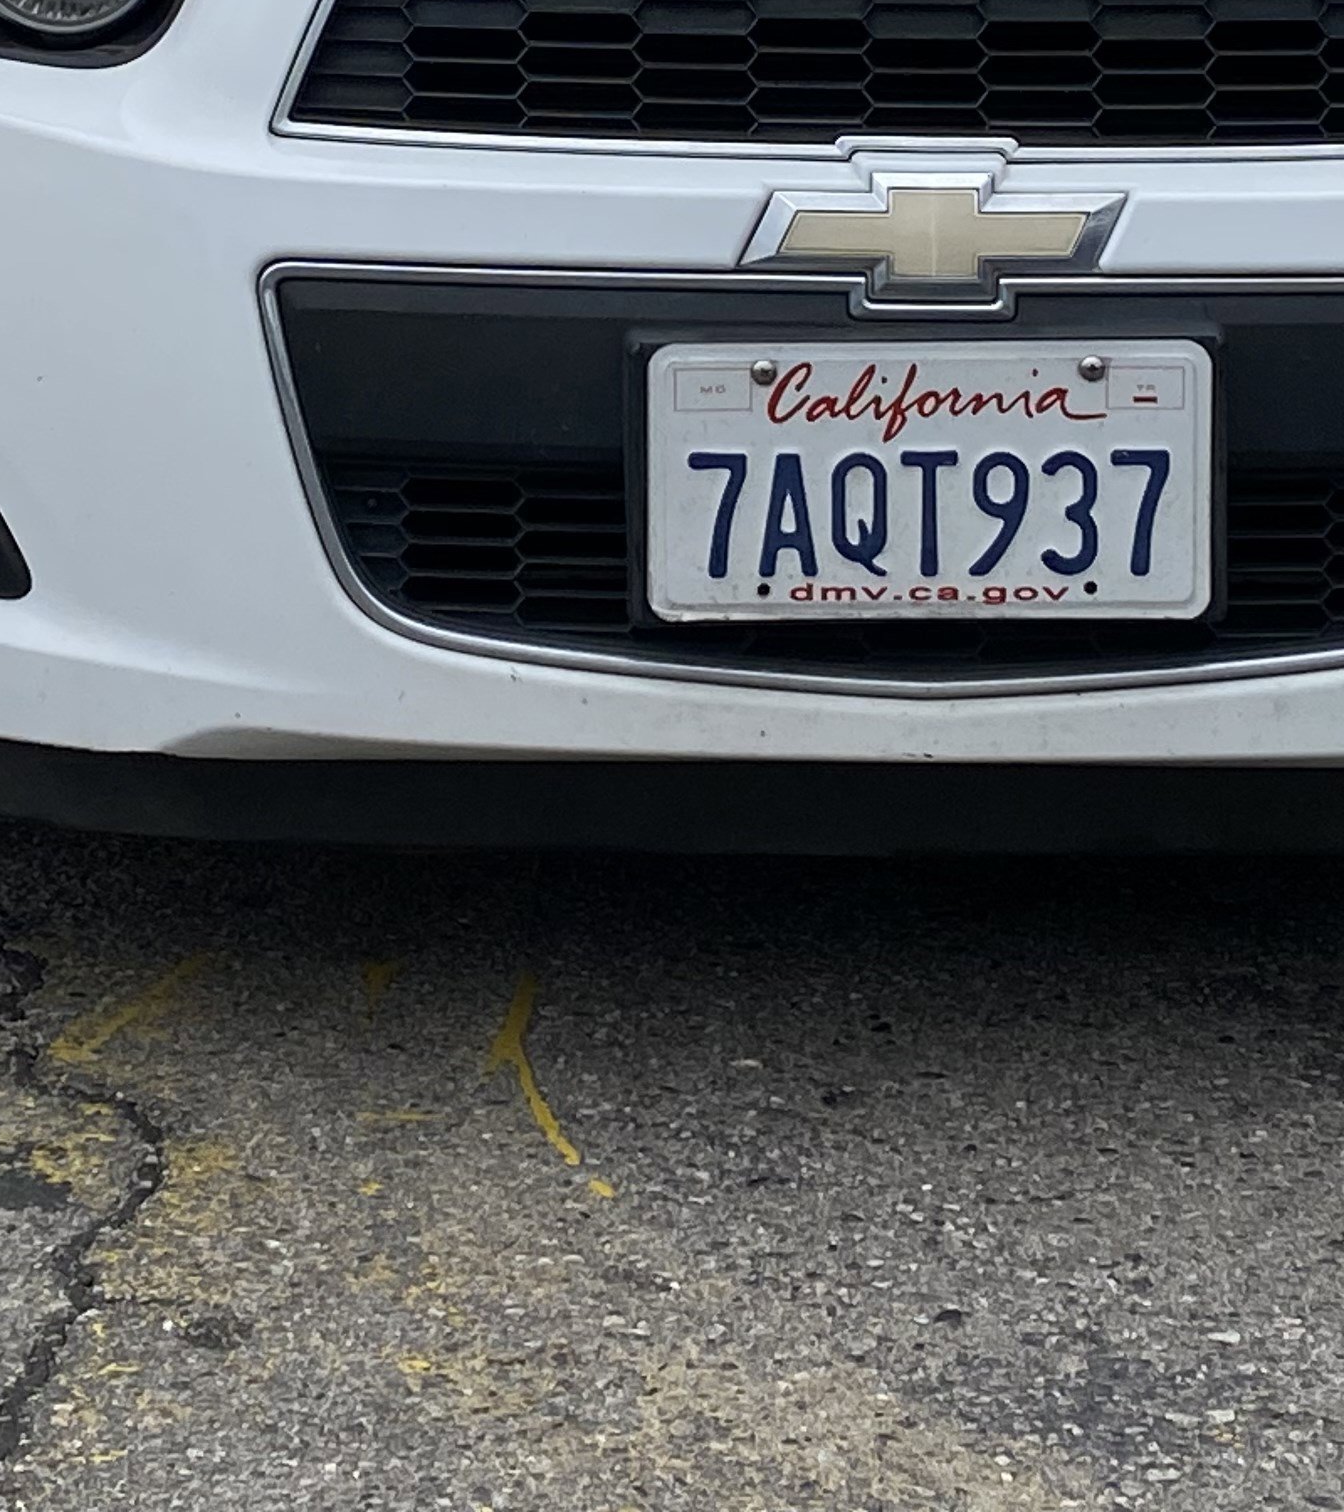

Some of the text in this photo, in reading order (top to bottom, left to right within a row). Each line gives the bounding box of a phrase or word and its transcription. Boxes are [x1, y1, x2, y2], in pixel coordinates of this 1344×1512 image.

[767, 362, 1108, 443] California
[688, 449, 1170, 578] 7AQT937
[789, 582, 1069, 605] dmv.ca.gov
